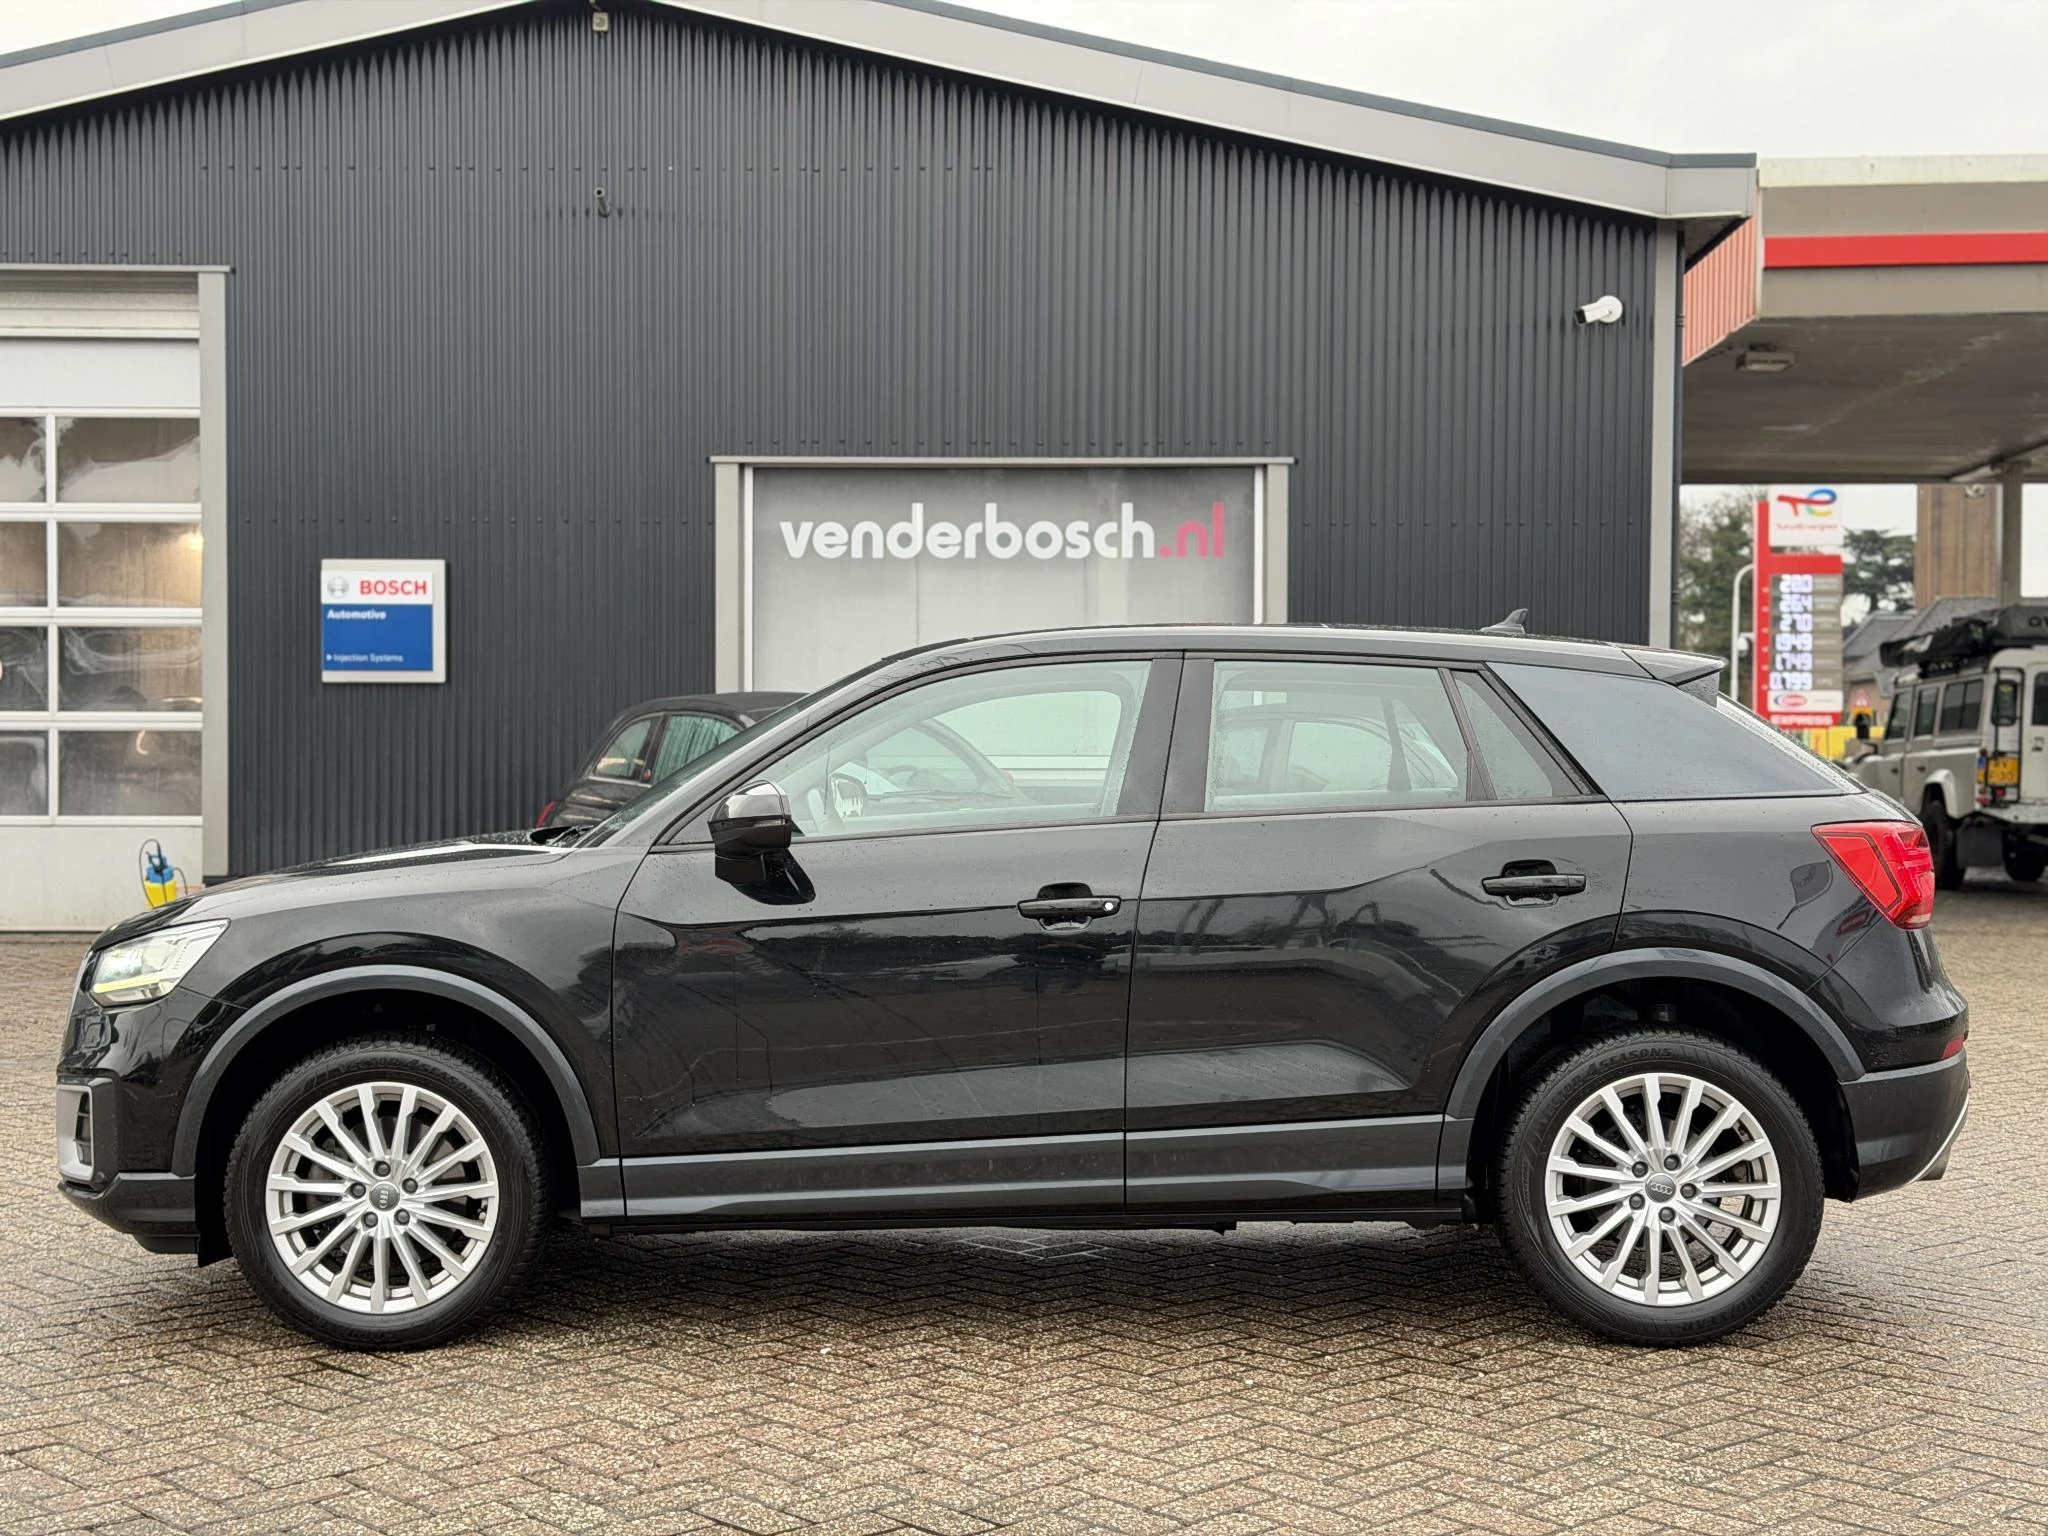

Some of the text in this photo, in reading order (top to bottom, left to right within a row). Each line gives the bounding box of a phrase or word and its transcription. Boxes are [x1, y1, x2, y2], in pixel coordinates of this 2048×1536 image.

[780, 502, 1226, 559] venderbosch.nl
[360, 580, 427, 595] BOSCH
[326, 609, 387, 620] Automotive
[334, 653, 404, 664] Injection Systems
